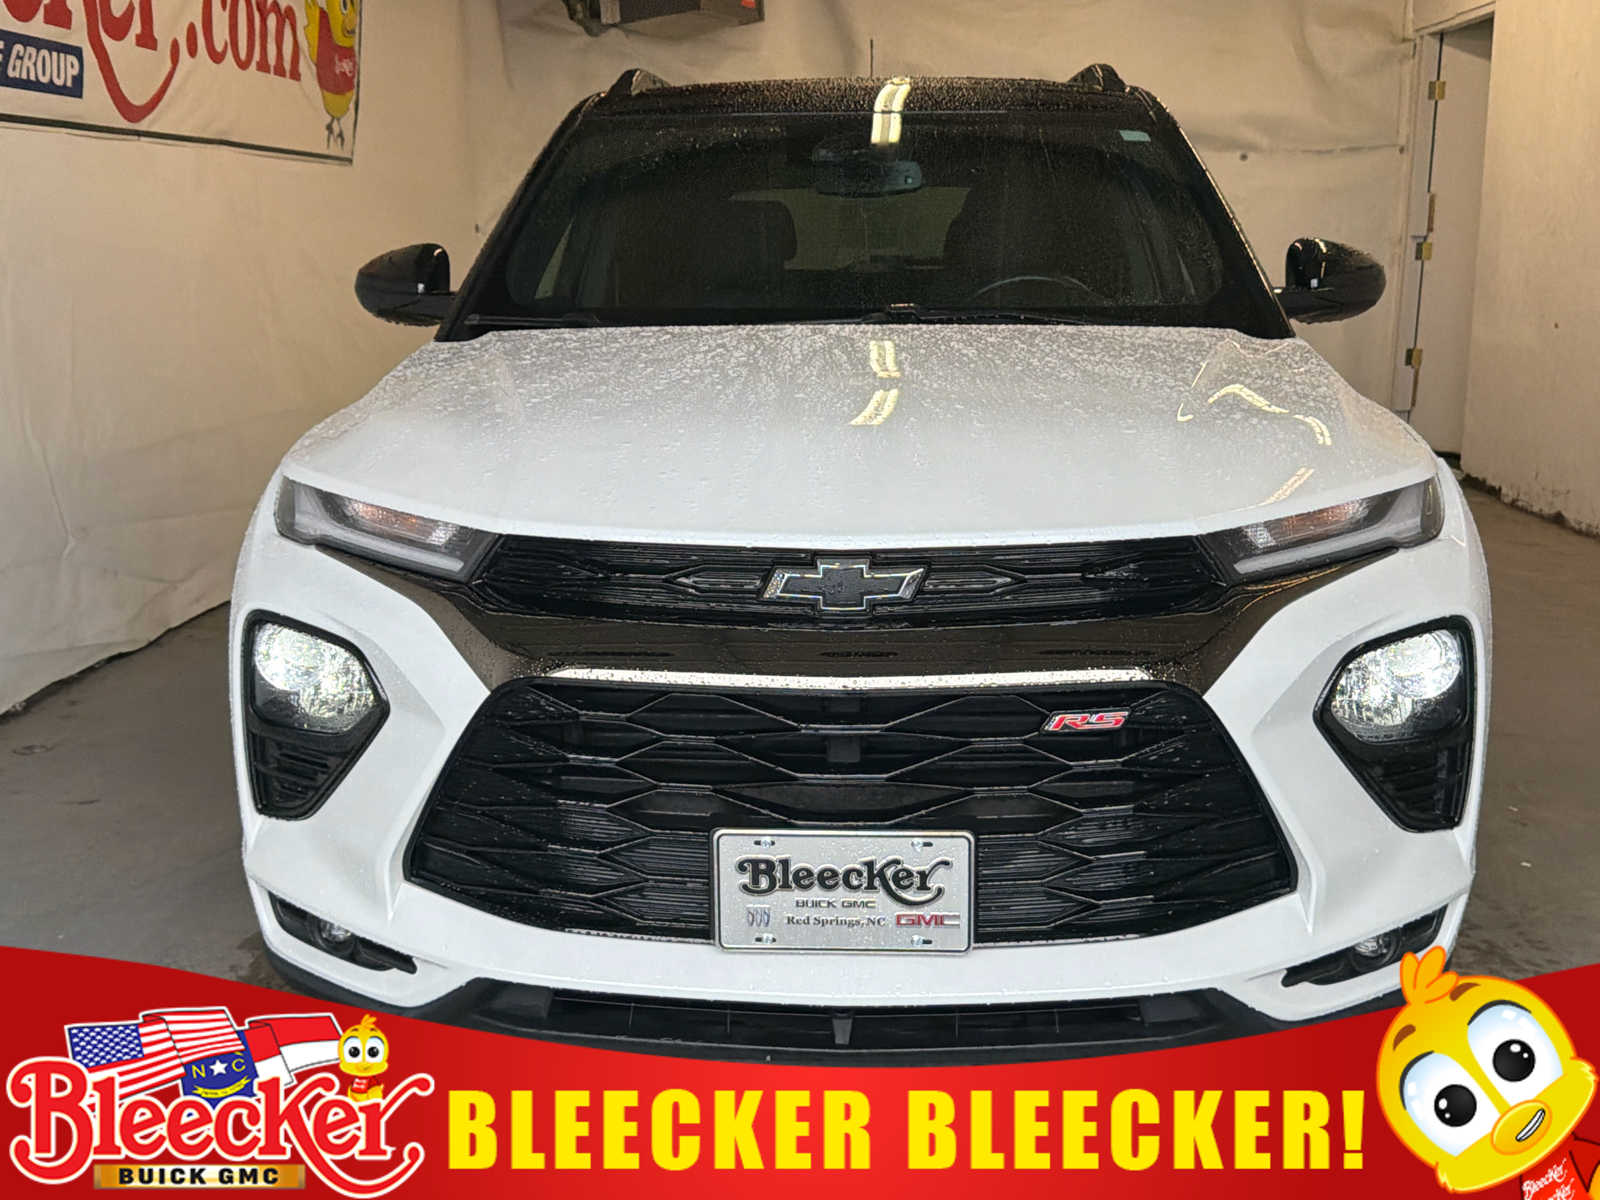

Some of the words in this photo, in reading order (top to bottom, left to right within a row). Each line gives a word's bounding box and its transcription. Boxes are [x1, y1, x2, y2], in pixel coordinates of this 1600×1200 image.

[7, 43, 80, 88] GROUP
[1048, 711, 1129, 731] RS
[795, 899, 836, 908] BUICK
[841, 899, 876, 908] GMC
[787, 915, 810, 925] Red
[866, 916, 886, 926] NC
[895, 914, 960, 927] GMC
